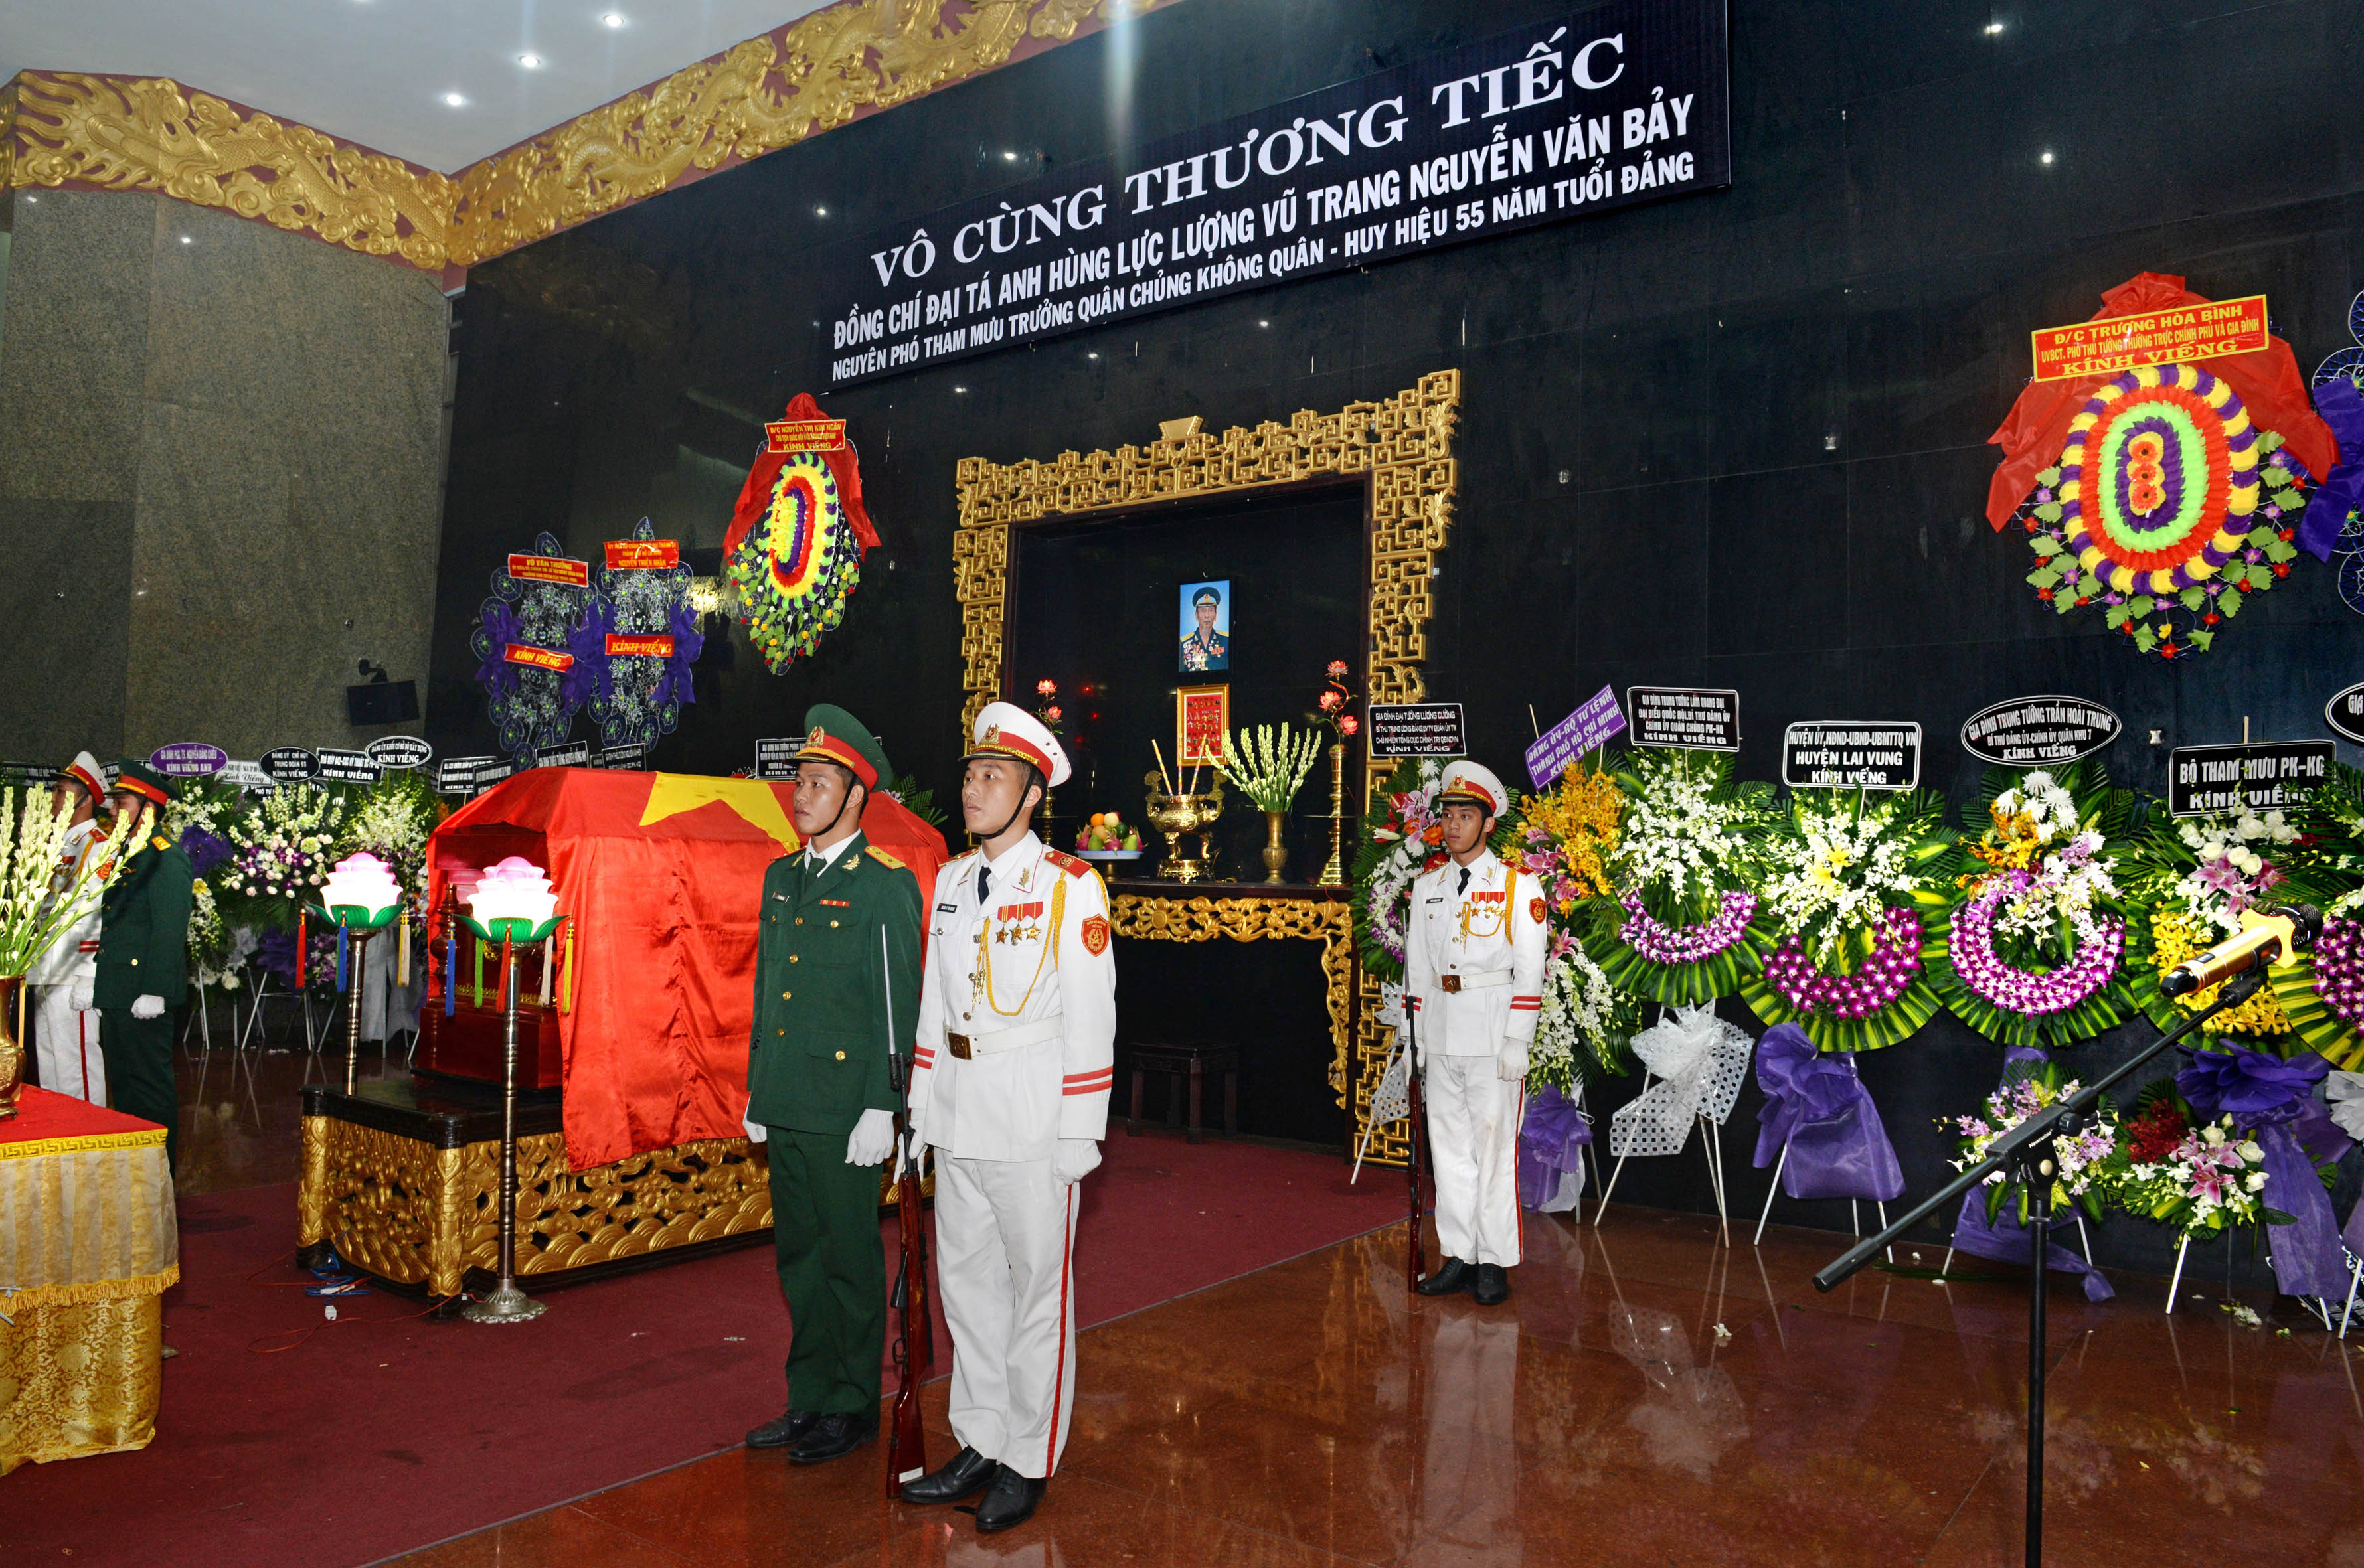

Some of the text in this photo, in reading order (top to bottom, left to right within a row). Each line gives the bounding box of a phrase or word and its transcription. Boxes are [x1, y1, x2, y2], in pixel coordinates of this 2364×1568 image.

[871, 27, 1624, 287] VÔ CÙNG THƯƠNG TIẾC
[834, 86, 1694, 349] ĐỒNG CHÍ ĐẠI TÁ ANH HÙNG LỰC LƯỢNG VŨ TRANG NGUYỄN VĂN BẢY
[833, 347, 886, 382] NGUYÊN
[890, 335, 919, 366] PHÓ
[924, 328, 966, 358] THAM
[970, 316, 1003, 347] MƯU
[1008, 299, 1073, 337] TRƯỞNG
[1078, 285, 1124, 321] QUÂN
[1130, 269, 1191, 307] CHỦNG
[1197, 254, 1263, 292] KHÔNG
[1269, 236, 1323, 275] QUÂN
[1345, 222, 1388, 257] HUY
[1395, 206, 1448, 245] HIỆU
[1456, 200, 1485, 231] 55
[1493, 186, 1546, 224] NĂM
[1553, 157, 1612, 209] TUỔI
[1620, 150, 1694, 194] ĐẢNG
[2055, 306, 2242, 345] Đ/C TRƯƠNG HÒA BÌNH
[2098, 337, 2123, 354] TƯỚNG
[2153, 329, 2173, 347] TRỰC
[2174, 326, 2197, 343] CHÍNH
[2199, 321, 2213, 340] PHỦ
[2215, 320, 2226, 337] VÀ
[2227, 321, 2240, 335] GIA
[2241, 317, 2260, 333] ĐÌNH
[2062, 340, 2238, 375] KÍNH VIẾNG
[611, 639, 672, 654] KÍNH VIẾNG
[513, 649, 562, 667] KÍNH VIẾNG
[2348, 694, 2364, 716] GIA
[1638, 708, 1647, 720] ĐẠI
[1661, 707, 1677, 720] QUỐC
[1694, 710, 1706, 721] THƯ
[1706, 709, 1722, 722] ĐẢNG
[1723, 710, 1731, 723] ỦY
[1968, 700, 2112, 741] GIA ĐÌNH TRUNG TƯỚNG TRẦN HOÀI TRUNG
[1528, 740, 1550, 763] ĐẢNG
[1576, 706, 1589, 723] TƯ
[1590, 689, 1613, 713] LỆNH
[1645, 719, 1661, 731] CHÍNH
[1670, 720, 1685, 733] QUÂN
[1531, 704, 1620, 776] THÀNH PHỐ HỒ CHÍ MINH
[1644, 732, 1727, 744] KÍNH VIẾNG
[1788, 728, 1813, 748] HUYỆN
[1905, 732, 1916, 746] VN
[1987, 733, 1993, 747] BÍ
[1994, 733, 2005, 746] THƯ
[2005, 730, 2021, 745] ĐẢNG
[2049, 728, 2057, 744] ỦY
[2057, 728, 2073, 744] QUÂN
[2074, 730, 2087, 741] KHU
[2088, 729, 2092, 740] 7
[377, 749, 420, 763] KÍNH VIẾNG
[1386, 744, 1451, 753] KÍNH VIẾNG
[1796, 748, 1903, 768] HUYỆN LAI VUNG
[2003, 742, 2076, 760] KÍNH VIẾNG
[166, 762, 181, 772] KÍNH
[272, 768, 308, 778] KÍNH VIẾNG
[323, 768, 374, 780] KÍNH VIẾNG
[1812, 767, 1887, 785] KÍNH VIẾNG
[2179, 759, 2197, 788] BỘ
[2201, 759, 2240, 783] THAM
[2244, 757, 2276, 780] MƯU
[2190, 790, 2241, 809] KÍNH
